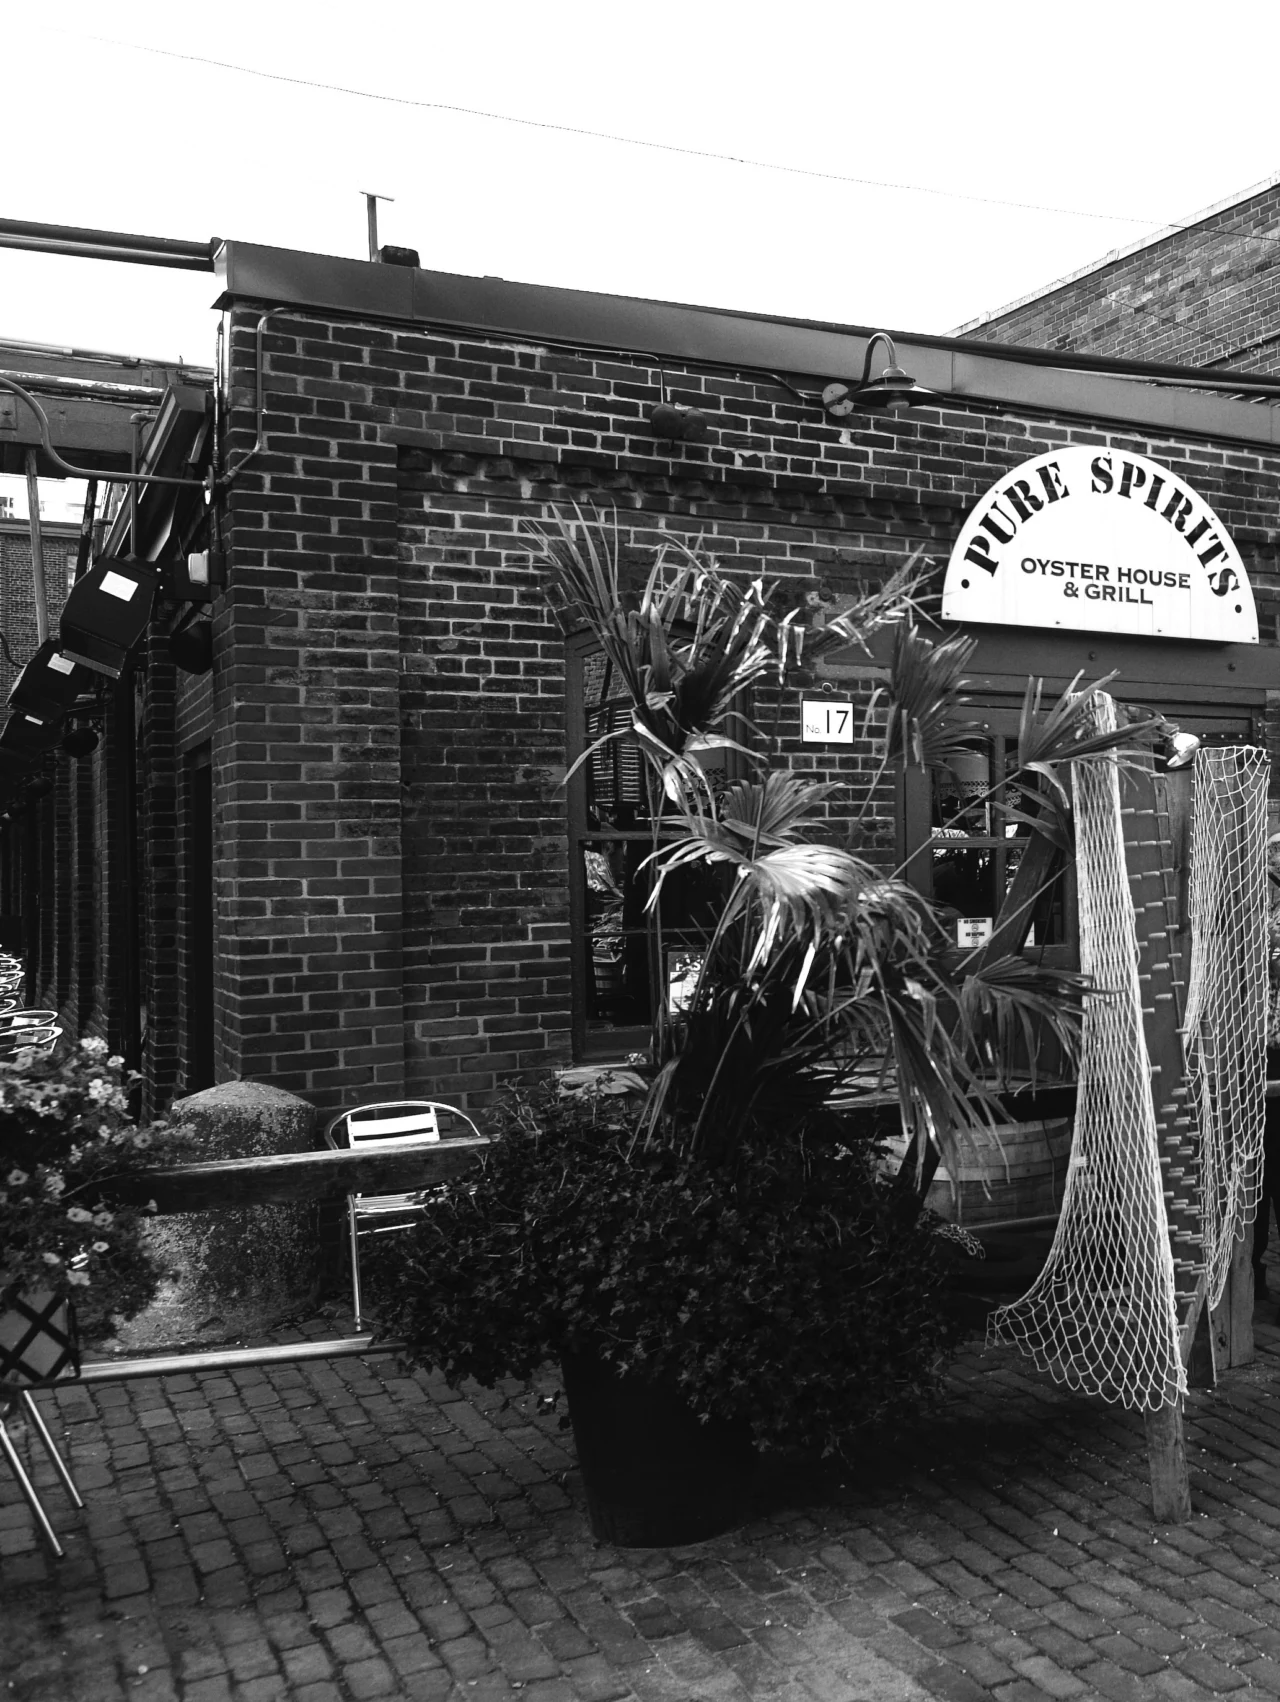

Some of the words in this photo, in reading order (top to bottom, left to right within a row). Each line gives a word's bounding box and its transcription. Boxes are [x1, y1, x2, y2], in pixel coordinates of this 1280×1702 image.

[963, 461, 1070, 577] PURE
[1090, 456, 1240, 597] SPIRITS
[1020, 557, 1110, 582] OYSTER
[1117, 567, 1191, 589] HOUSE
[1063, 581, 1079, 598] &
[1084, 584, 1153, 605] GRILL
[806, 724, 821, 734] No.
[826, 710, 849, 734] 17
